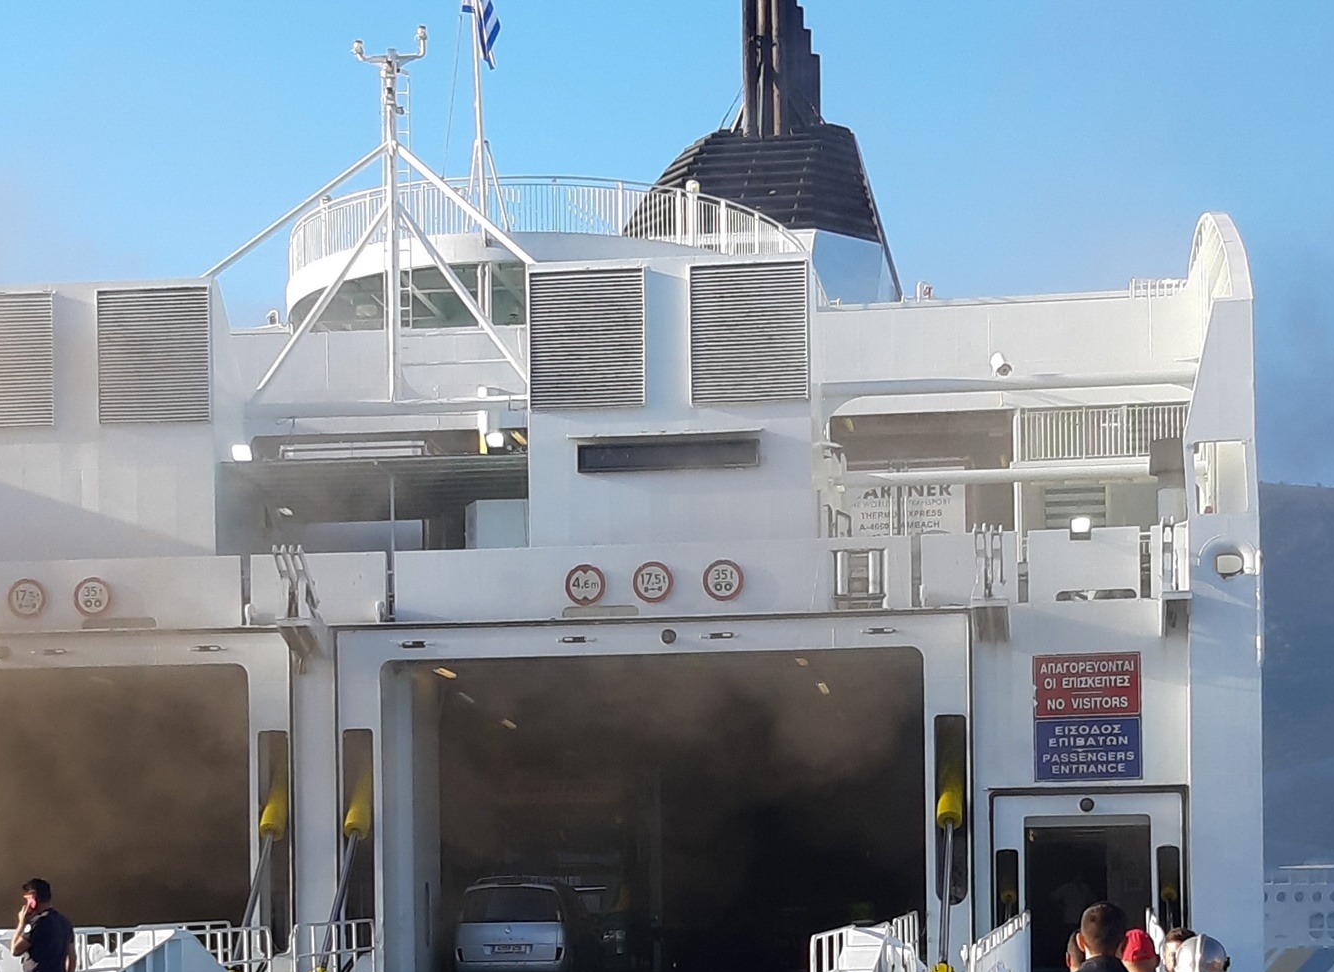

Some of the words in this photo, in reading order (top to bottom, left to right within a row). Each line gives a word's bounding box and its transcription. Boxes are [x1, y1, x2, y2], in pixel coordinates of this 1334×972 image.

[904, 508, 943, 519] XPRESS
[1040, 660, 1134, 674] ΑΠΑΓΟΡΕΥΟΝΤΑΙ
[1044, 678, 1056, 690] ΟΙ
[1062, 675, 1131, 689] ΕΠΙΣΚΕΠΤΕΣ
[1047, 699, 1065, 711] NO
[1071, 696, 1129, 709] VISITORS
[1054, 724, 1122, 735] ΕΙΣΟΔΟΣ
[1048, 736, 1128, 748] ΕΠΙΒΑΤΩΝ
[1042, 751, 1135, 763] PASSENGERS
[1052, 763, 1126, 774] ENTRANCE
